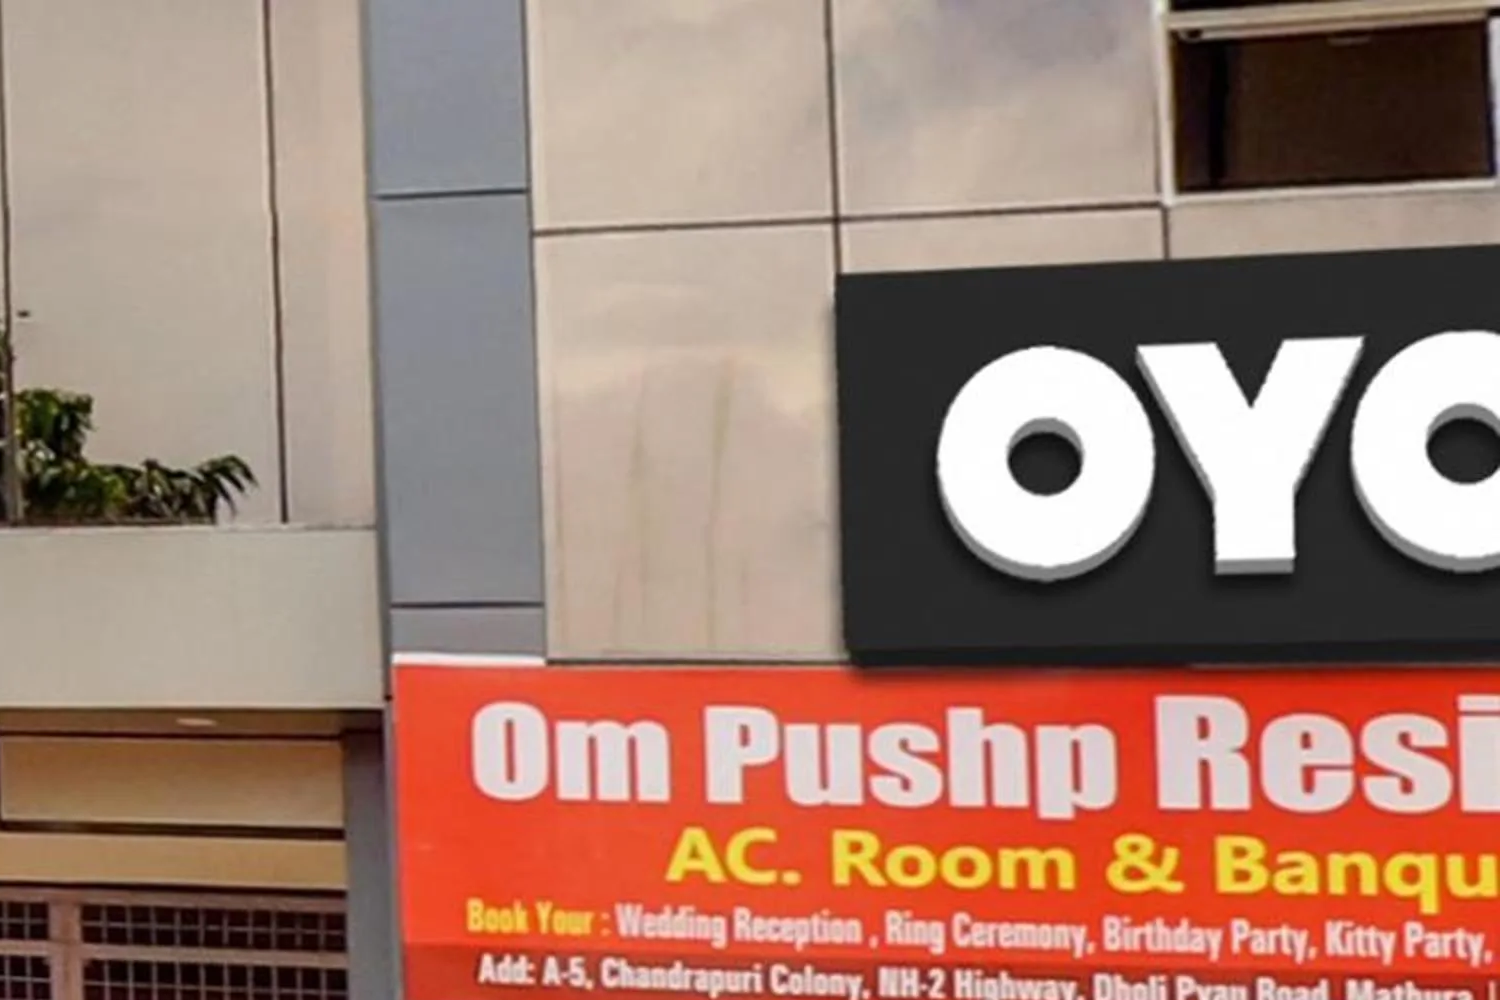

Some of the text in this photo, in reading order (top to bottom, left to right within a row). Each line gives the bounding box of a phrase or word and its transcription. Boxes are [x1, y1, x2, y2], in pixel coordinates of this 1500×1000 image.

[937, 329, 1500, 582] OYO
[472, 694, 1500, 820] Om Pushp Resi
[665, 827, 1500, 914] AC. Room & Banqu
[467, 898, 528, 934] Book
[535, 901, 593, 936] Your
[615, 903, 728, 949] Wedding
[733, 907, 862, 951] Reception
[885, 909, 945, 955] Ring
[952, 912, 1096, 959] Ceremony,
[1102, 915, 1223, 962] Birthday
[1230, 917, 1318, 965] Party,
[1324, 919, 1396, 966] Kitty
[1404, 920, 1493, 968] Party,
[478, 953, 535, 985] Add:
[542, 955, 594, 991] A-5,
[600, 957, 763, 1000] Chandrapuri
[878, 966, 946, 999] NH-2
